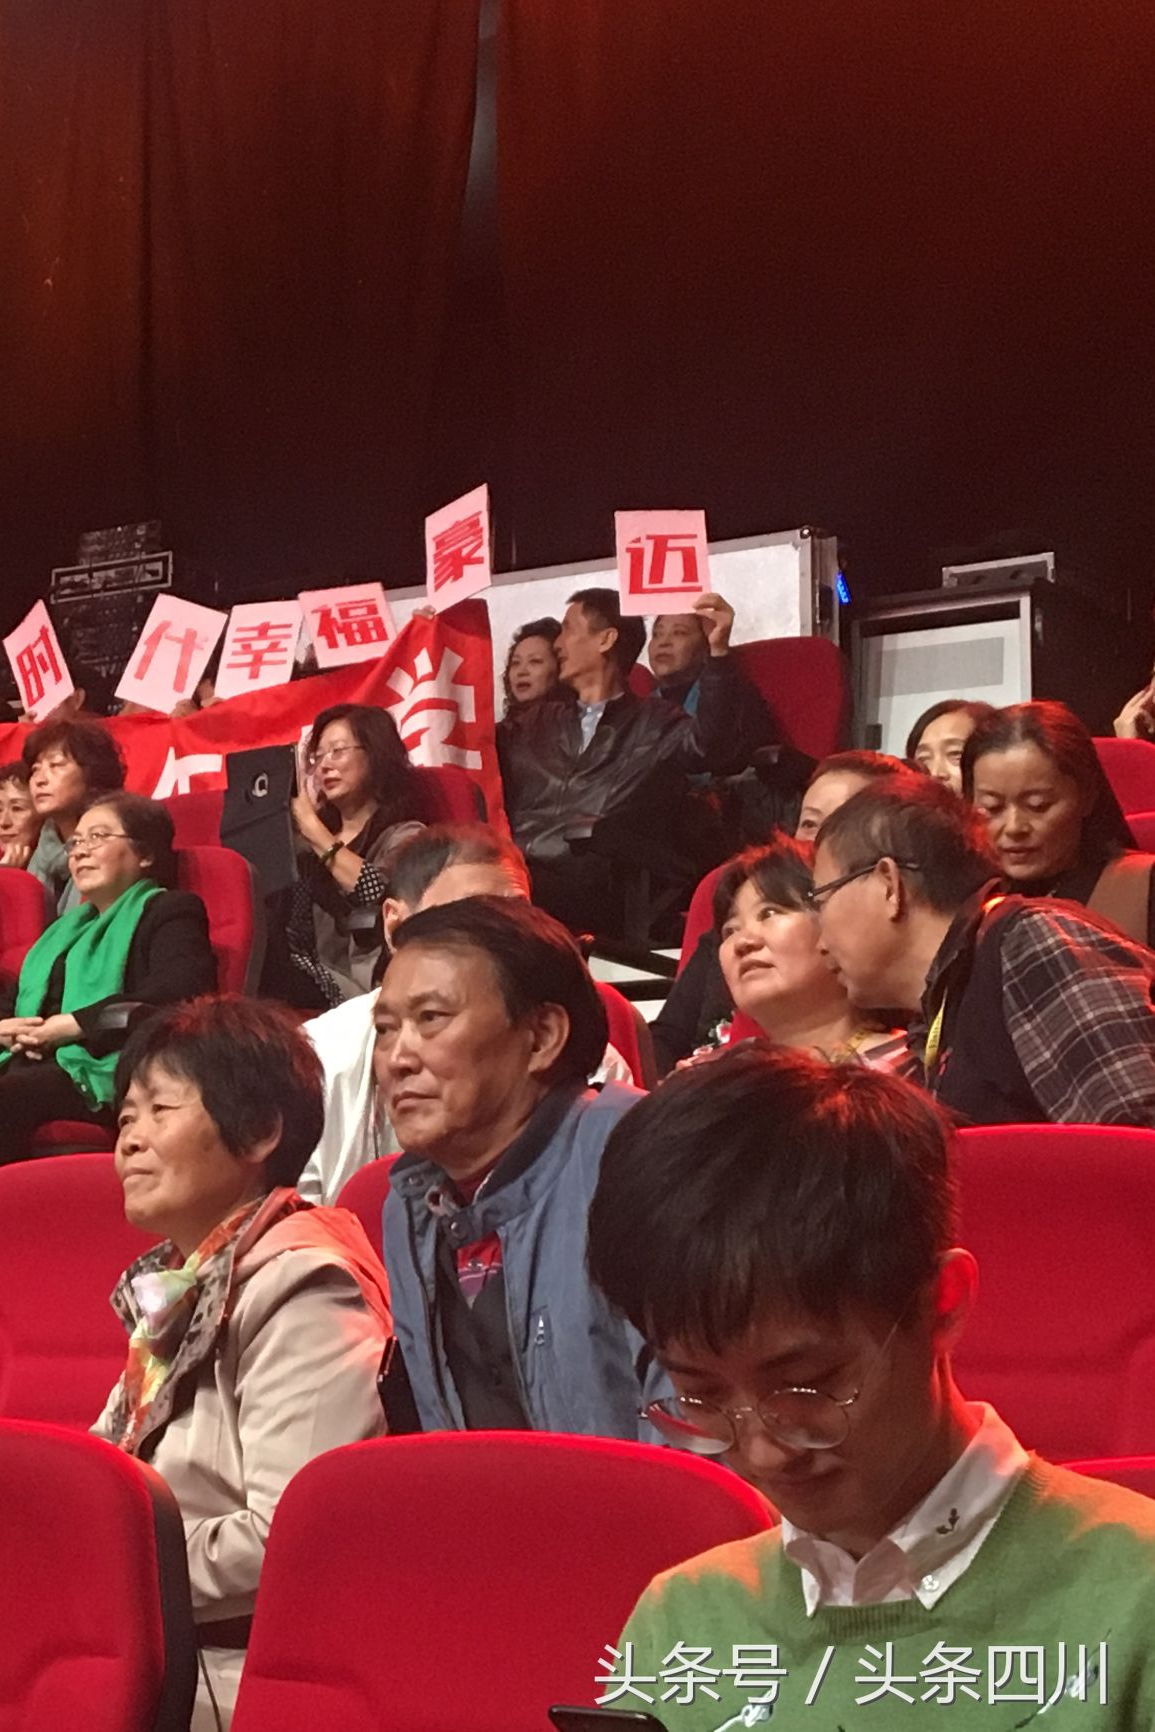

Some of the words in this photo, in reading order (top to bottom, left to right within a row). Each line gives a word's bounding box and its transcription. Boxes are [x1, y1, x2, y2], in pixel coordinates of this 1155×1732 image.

[432, 511, 485, 592] 豪
[626, 534, 703, 595] 迈
[226, 621, 294, 681] 幸
[312, 598, 389, 650] 福
[16, 625, 63, 708] 时
